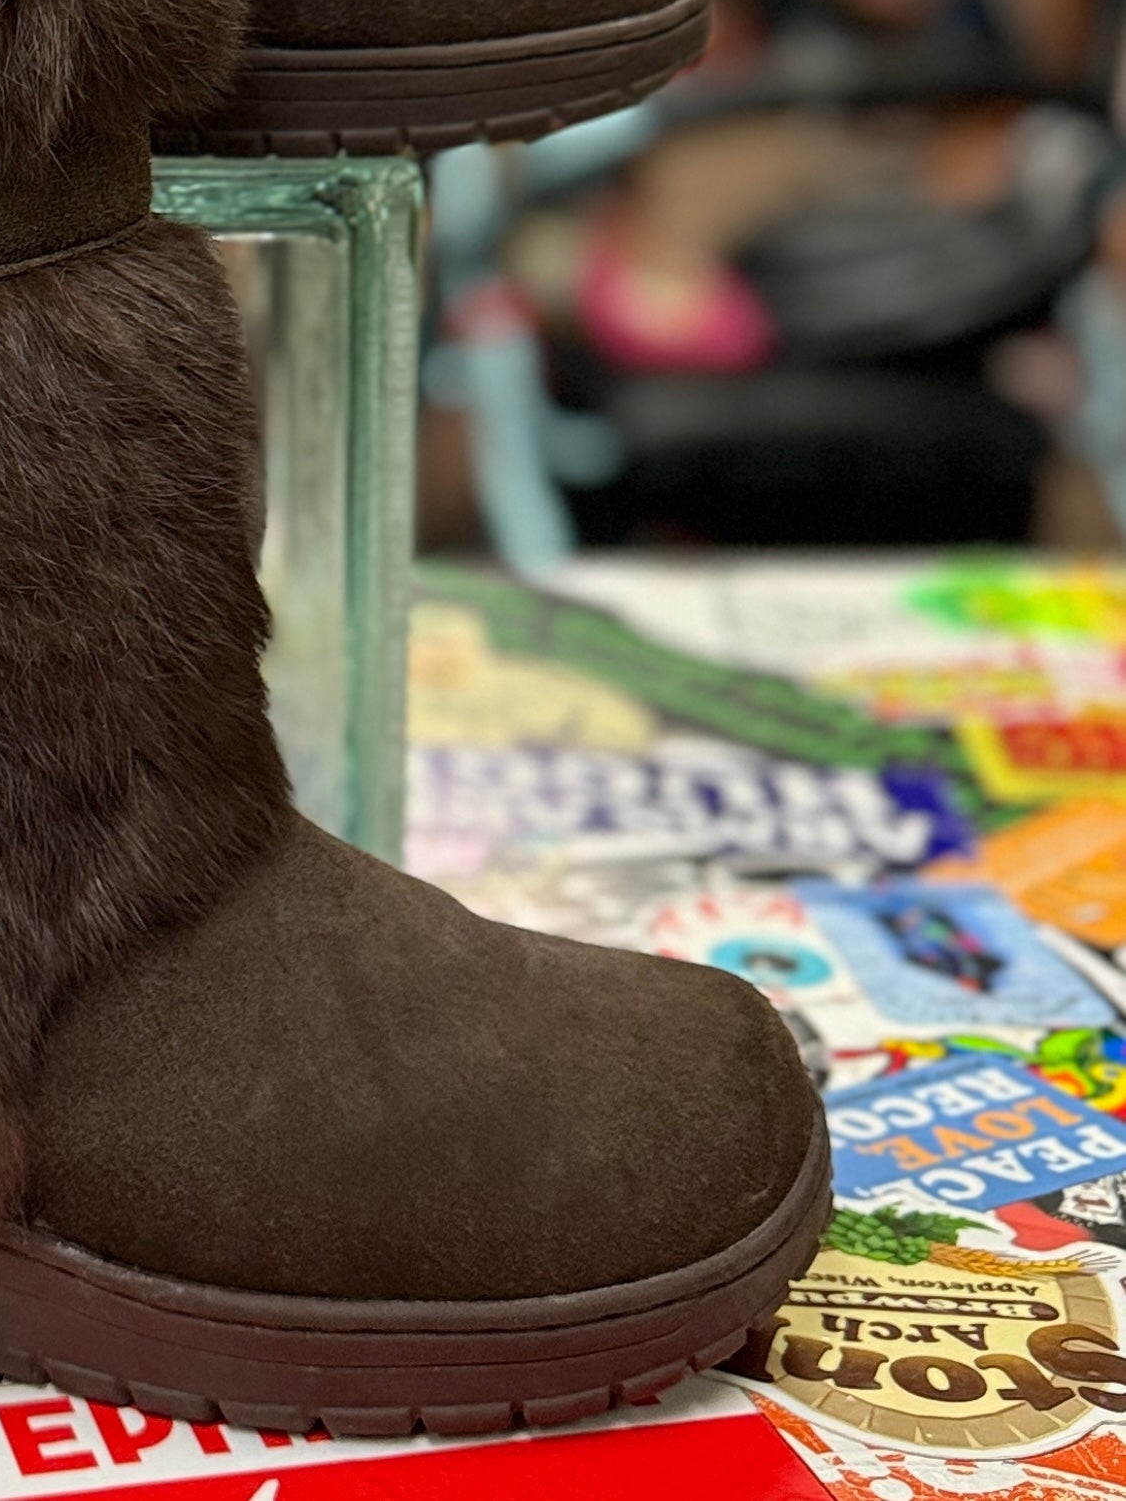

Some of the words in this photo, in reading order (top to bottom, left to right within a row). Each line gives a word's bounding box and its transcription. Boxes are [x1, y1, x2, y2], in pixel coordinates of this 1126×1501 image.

[830, 1066, 1034, 1148] RECO
[853, 1096, 1085, 1171] LOVE,
[796, 1272, 882, 1289] Wisc
[888, 1274, 1040, 1297] Appleton,
[788, 1289, 1028, 1319] Brewpu
[822, 1312, 990, 1350] Arch
